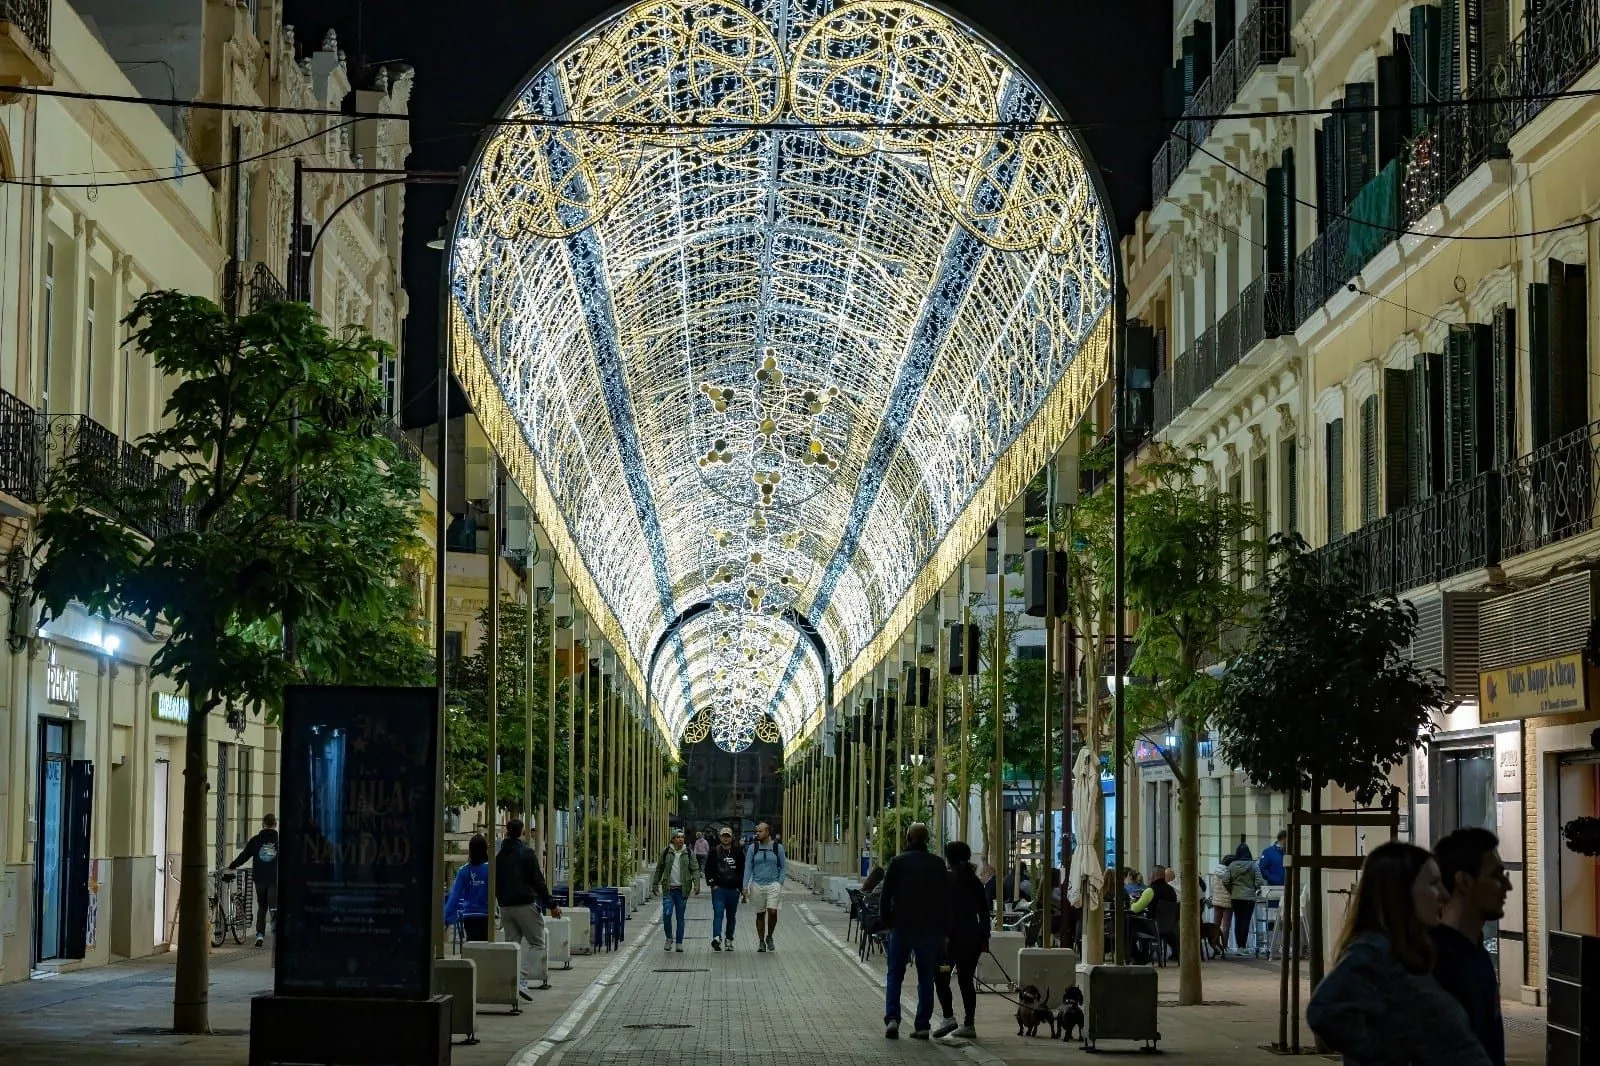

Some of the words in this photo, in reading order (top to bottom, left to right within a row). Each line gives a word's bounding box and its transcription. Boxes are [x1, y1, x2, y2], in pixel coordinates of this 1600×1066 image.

[1506, 669, 1525, 699] Viajes
[1527, 665, 1548, 696] Happy
[1549, 663, 1554, 687] &
[1555, 659, 1576, 689] Cheap
[303, 832, 411, 865] NAVIDAD
